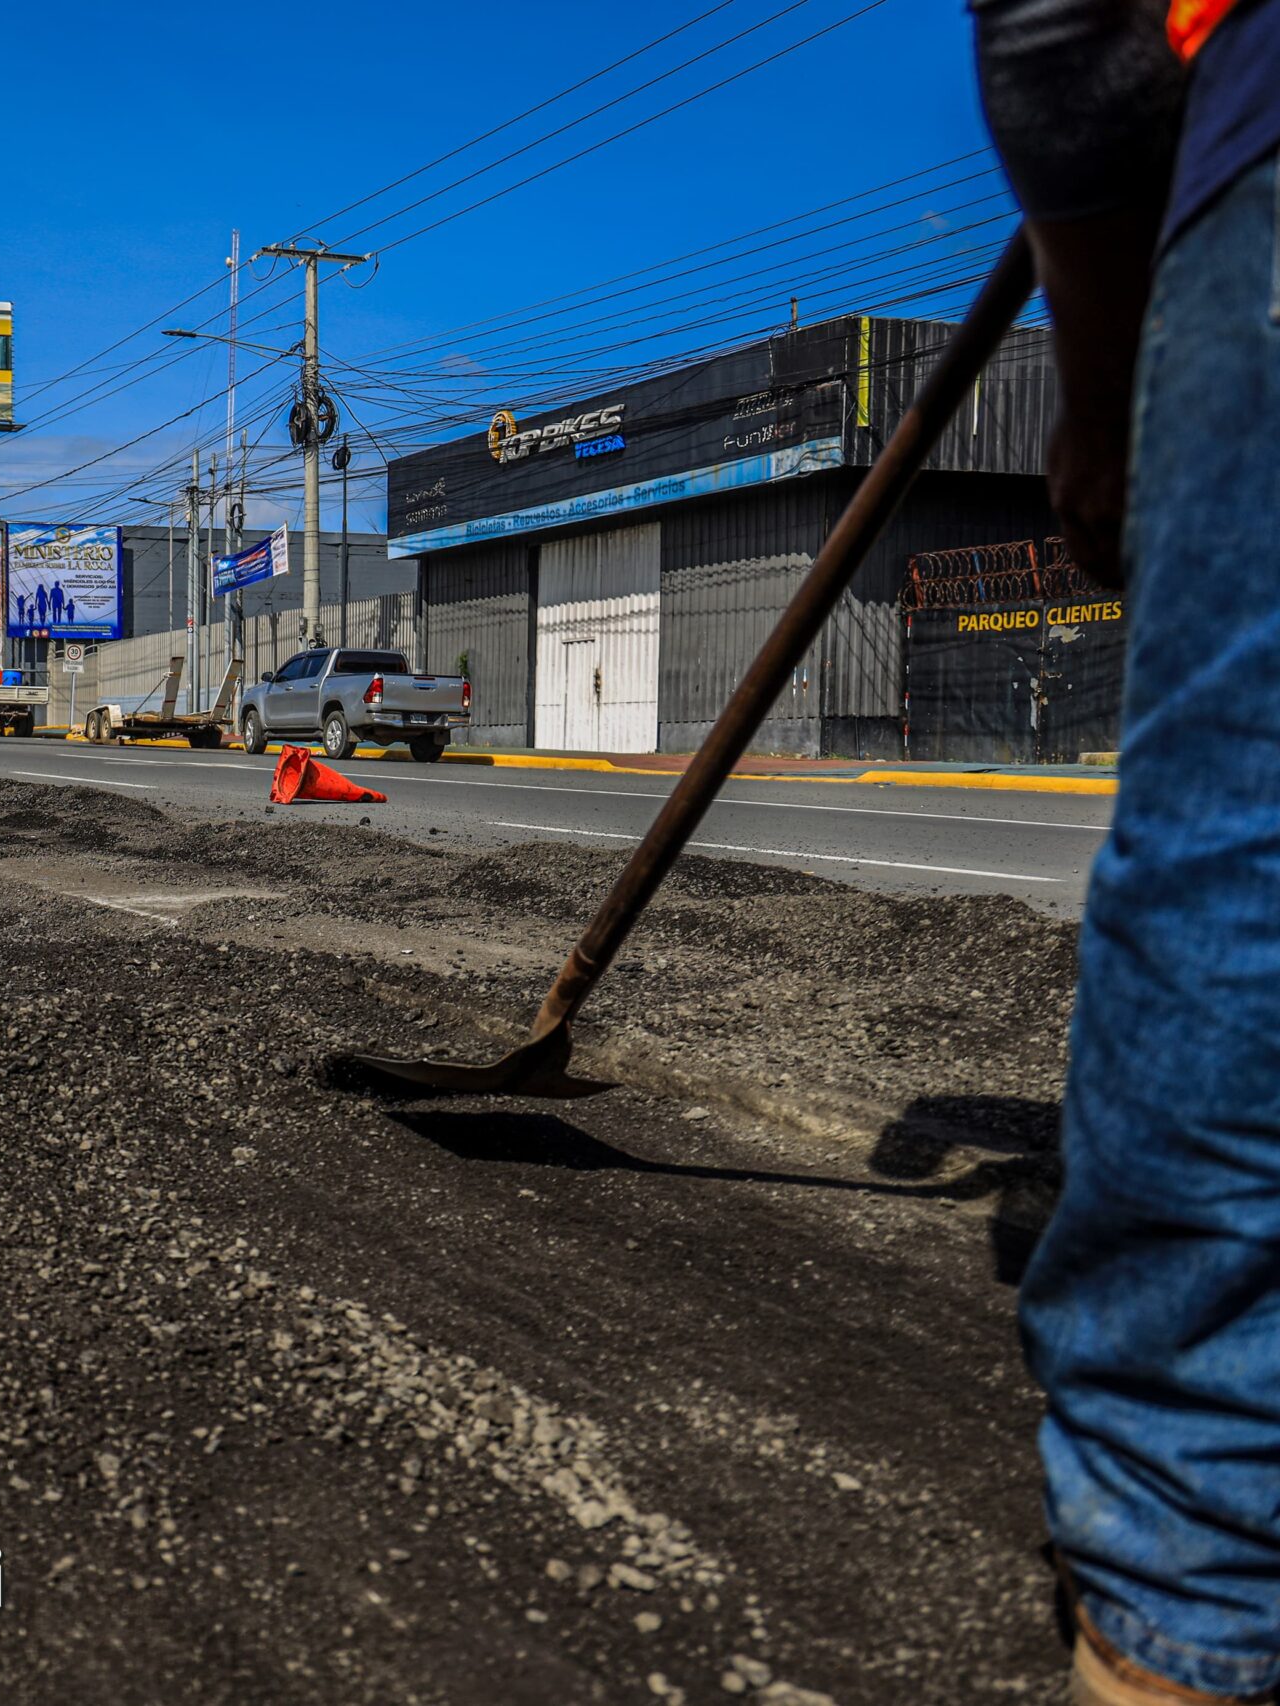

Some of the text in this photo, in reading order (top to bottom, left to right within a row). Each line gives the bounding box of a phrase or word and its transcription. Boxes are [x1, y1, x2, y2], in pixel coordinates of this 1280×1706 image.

[513, 506, 560, 527] Repuestos
[568, 493, 624, 516] Accesorios
[633, 479, 686, 501] Servicios
[14, 544, 114, 561] MINISTERIO
[67, 561, 81, 570] LA
[84, 561, 114, 571] ROCA
[958, 601, 1122, 632] PARQUEO CLIENTES
